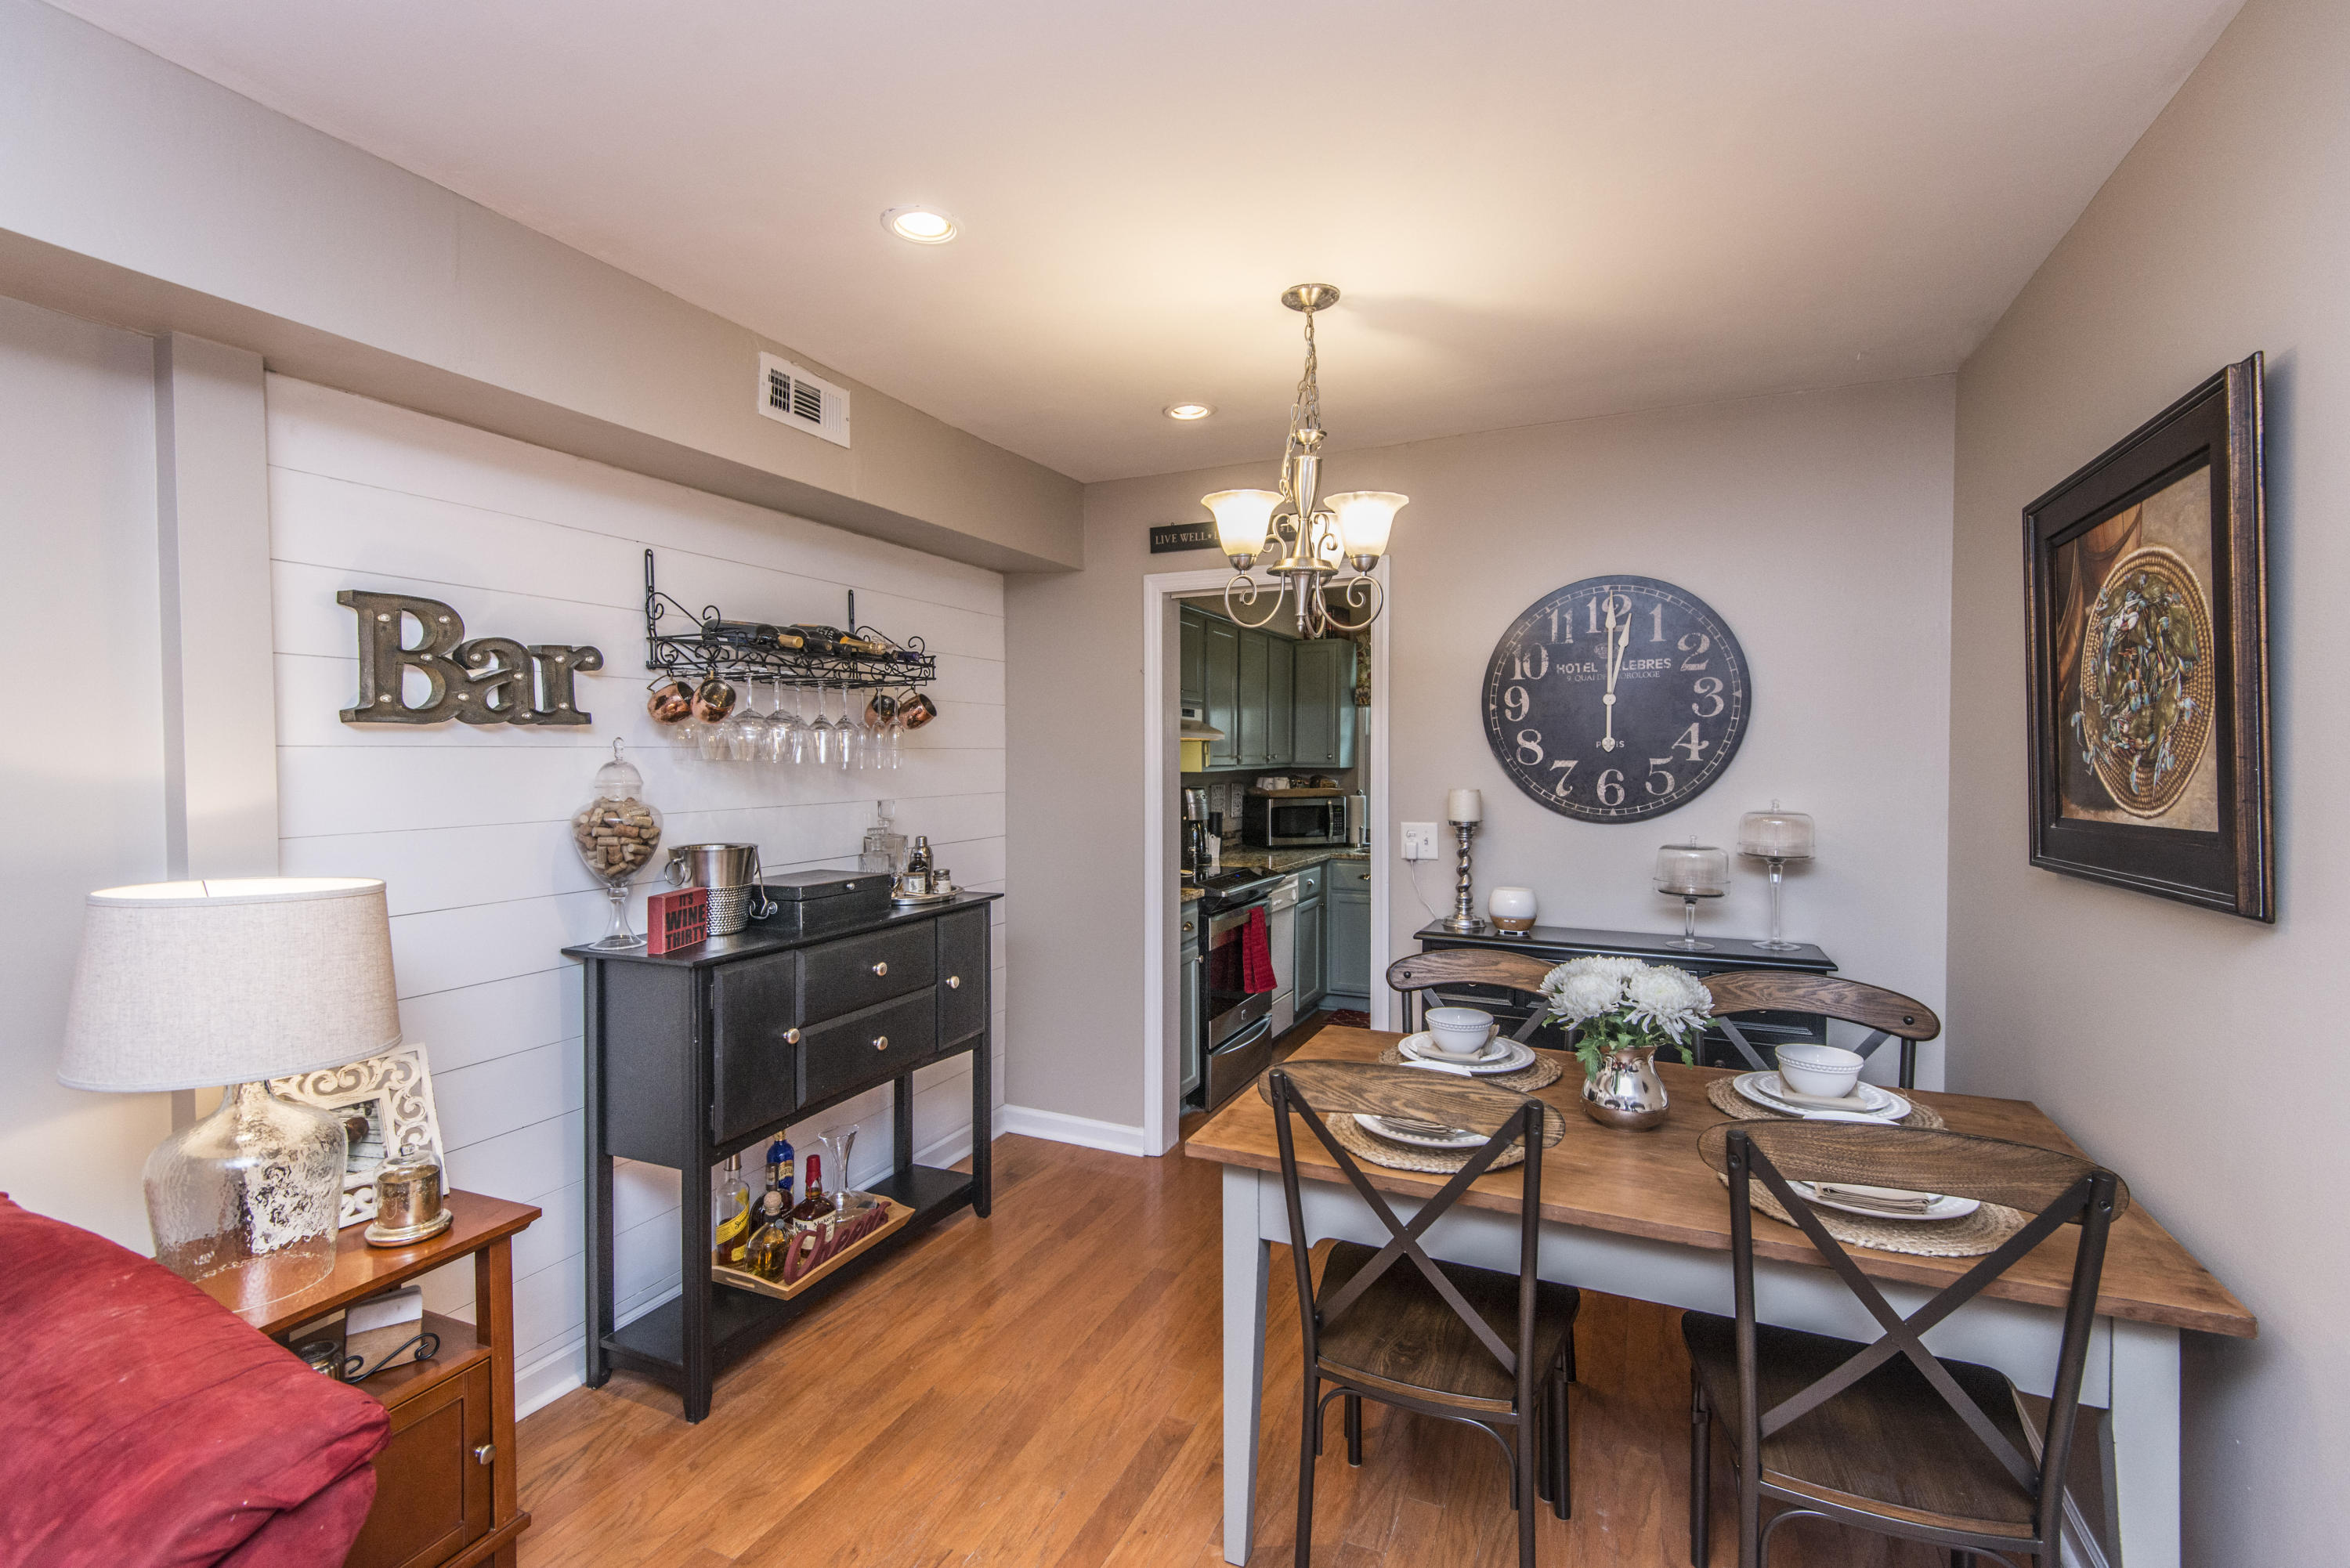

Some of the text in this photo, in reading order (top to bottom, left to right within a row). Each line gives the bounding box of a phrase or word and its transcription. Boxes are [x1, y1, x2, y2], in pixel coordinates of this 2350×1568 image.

[1155, 534, 1177, 544] LIVE
[1180, 532, 1206, 542] WELL
[1548, 608, 1574, 645] 11
[1586, 594, 1632, 634] 12
[1649, 603, 1666, 641] 1
[337, 590, 603, 724] Bar
[1509, 642, 1549, 680] 10
[1556, 662, 1598, 674] HOTEL
[1677, 632, 1710, 671] 2
[1504, 686, 1530, 721] 9
[1692, 677, 1724, 717] 3
[1517, 728, 1544, 765] 8
[1671, 722, 1709, 761] 4
[1549, 760, 1578, 797] 7
[1596, 768, 1625, 806] 6
[1645, 756, 1676, 796] 5
[665, 903, 706, 932] WINE
[665, 924, 706, 950] THIRTY
